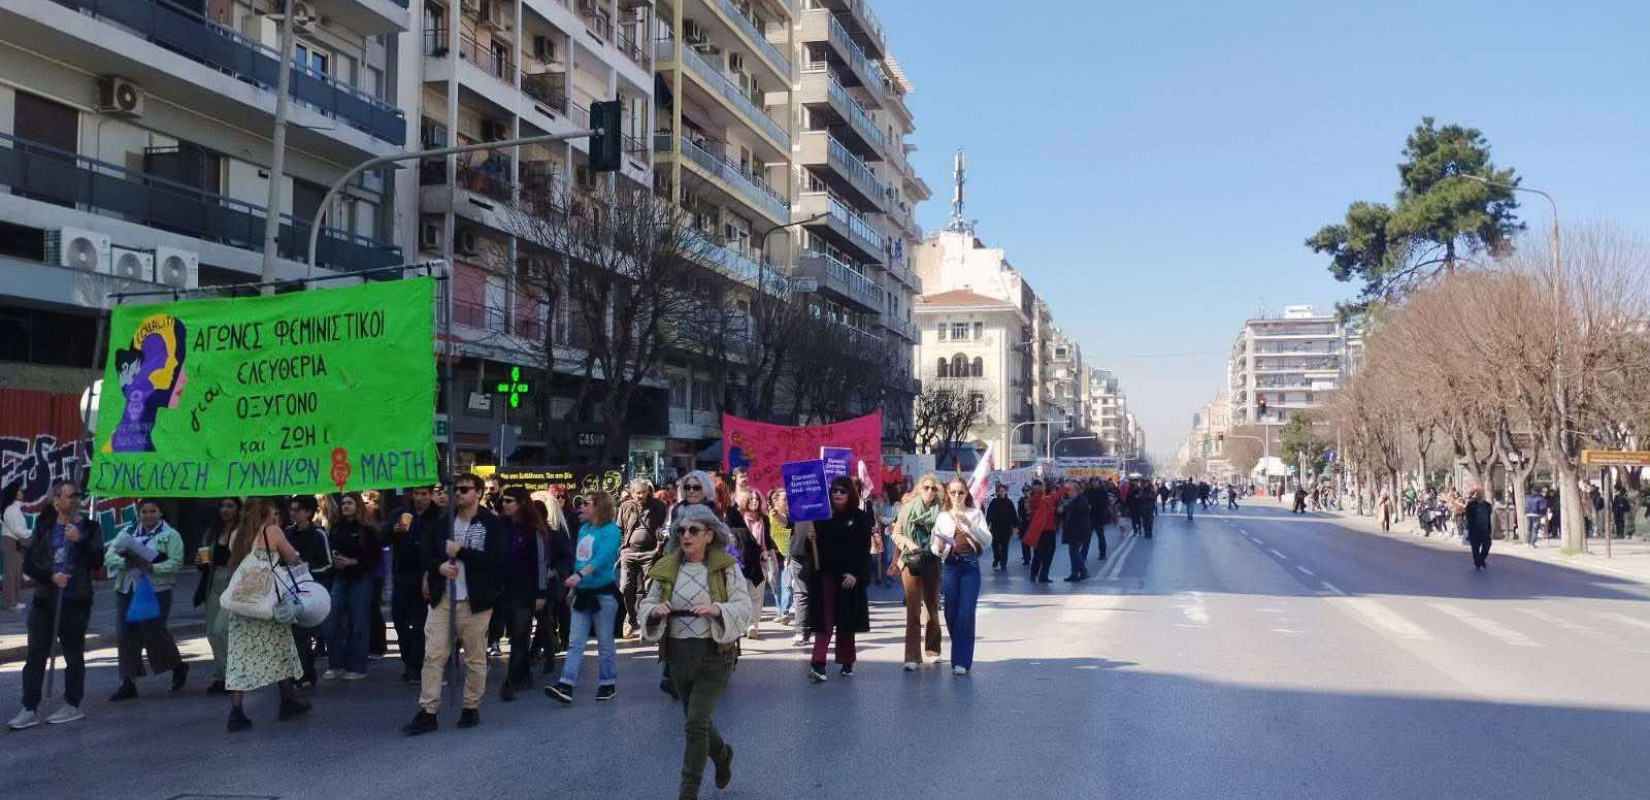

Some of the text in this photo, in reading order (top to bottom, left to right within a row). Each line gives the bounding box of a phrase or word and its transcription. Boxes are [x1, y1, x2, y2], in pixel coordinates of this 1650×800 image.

[193, 310, 386, 352] ΑΓΩΝΕΣ ΦΕΜΙΝΙΣΤΙΚΟΙ
[236, 354, 328, 385] ΕΛΕΥΘΕΡΙΑ
[236, 391, 318, 420] ΟΞΥΓΟΝΟ
[96, 460, 209, 492] ΣΥΝΕΛΕΥΣΗ
[227, 457, 321, 490] ΓΥΝΑΙΚΩΝ
[360, 449, 426, 483] ΜΑΡΤΗ
